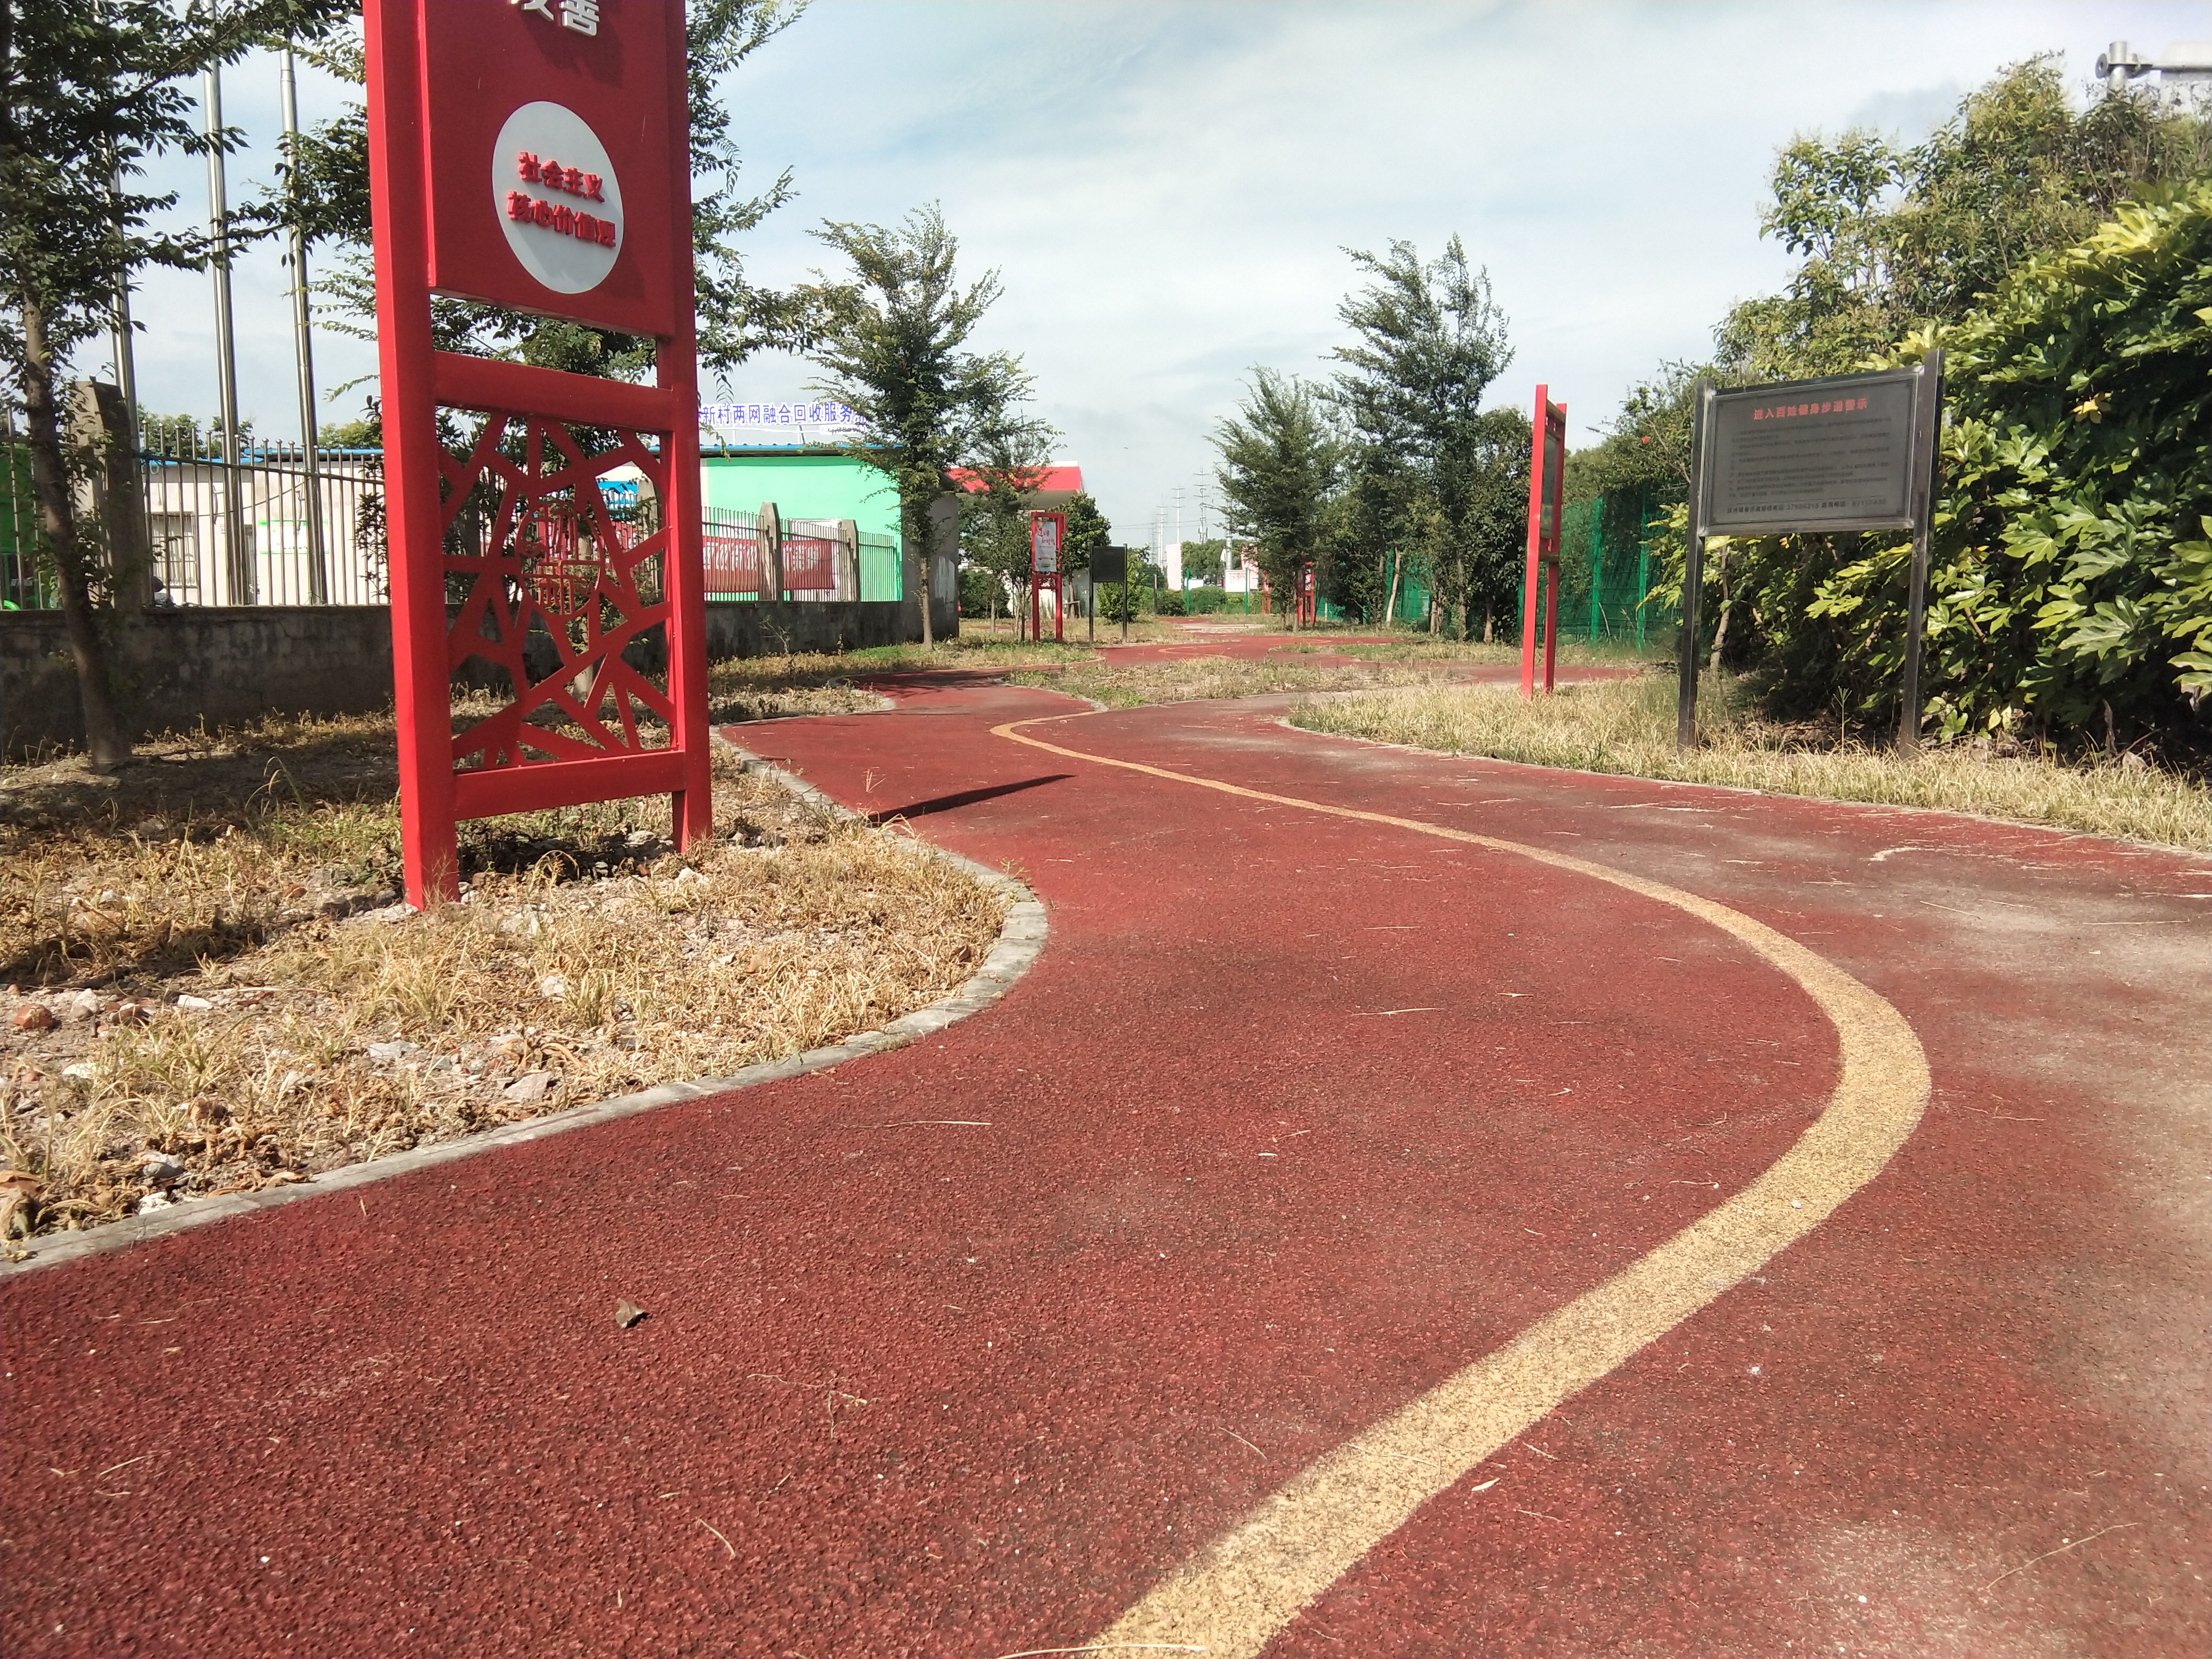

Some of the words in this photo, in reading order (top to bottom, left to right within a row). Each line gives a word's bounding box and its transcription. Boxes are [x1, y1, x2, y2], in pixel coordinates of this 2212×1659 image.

[518, 152, 605, 203] 社会主义
[507, 191, 616, 247] 核心价值观
[698, 403, 870, 425] 新村两网融合回收服务
[1754, 398, 1867, 420] 进入百姓健身步道警示
